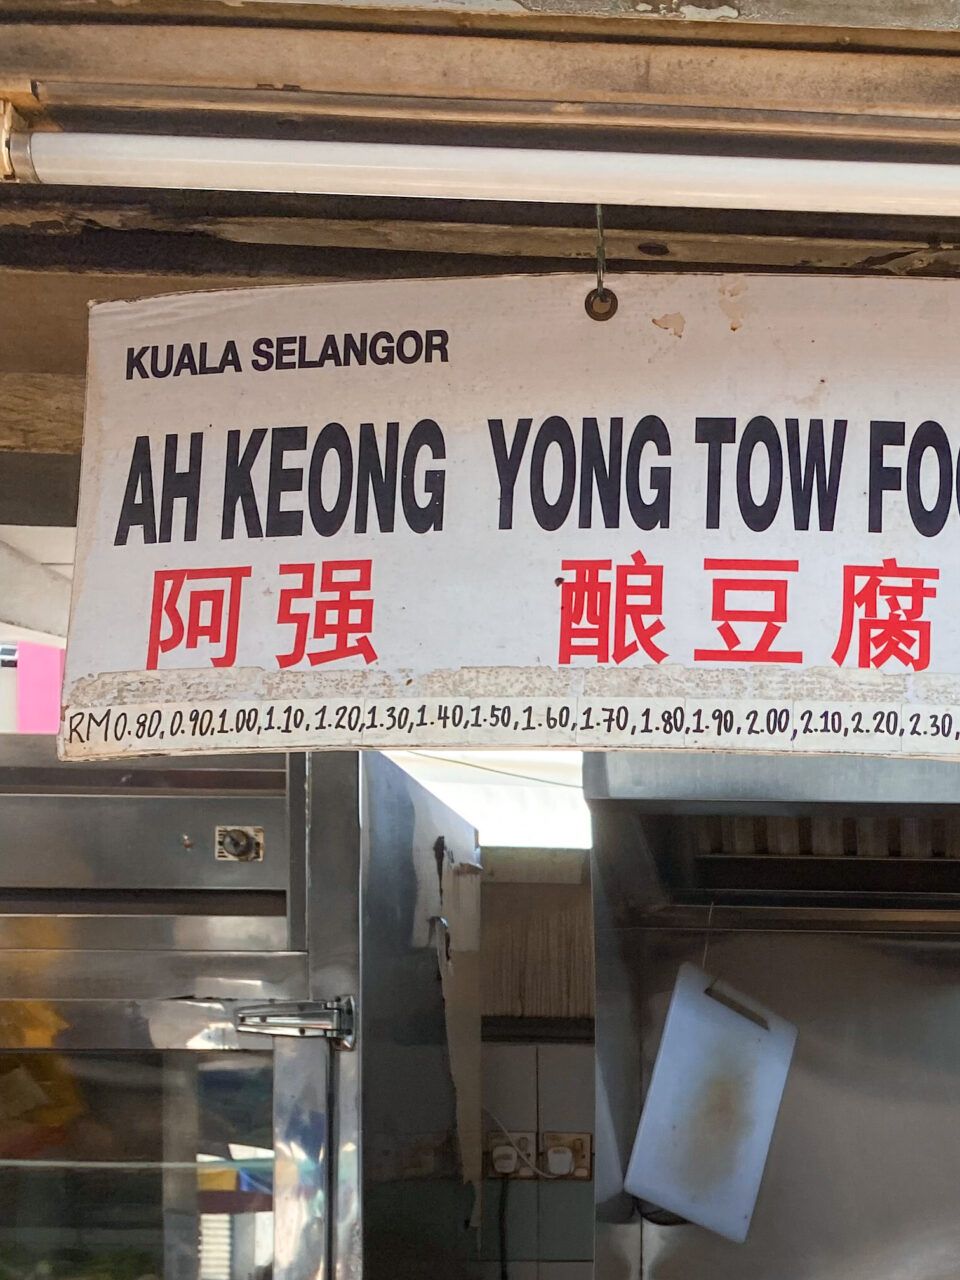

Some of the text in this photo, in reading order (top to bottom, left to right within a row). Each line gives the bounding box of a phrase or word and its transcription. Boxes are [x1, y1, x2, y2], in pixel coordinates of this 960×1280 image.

[126, 330, 449, 380] KUALA SELANGOR
[114, 432, 204, 546] AH
[221, 418, 446, 540] KEONG
[488, 415, 672, 532] YONG
[695, 415, 848, 532] TOW
[146, 559, 378, 670] 阿强
[558, 550, 940, 672] 酿豆腐
